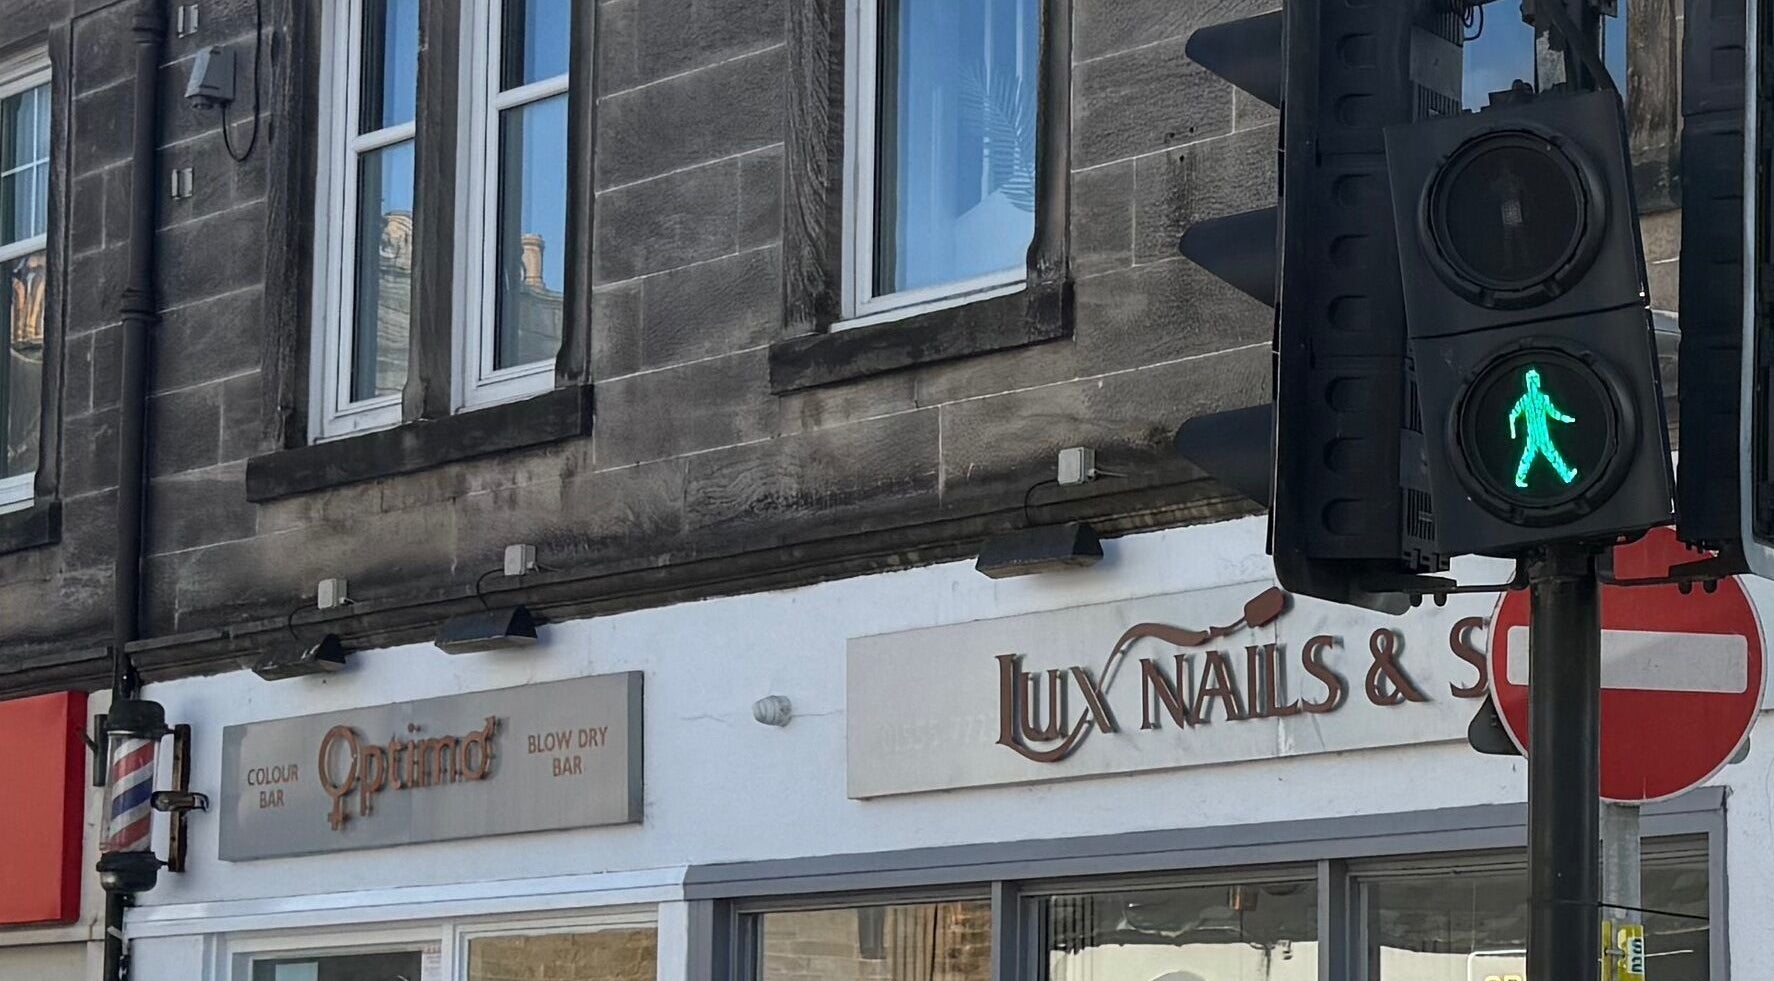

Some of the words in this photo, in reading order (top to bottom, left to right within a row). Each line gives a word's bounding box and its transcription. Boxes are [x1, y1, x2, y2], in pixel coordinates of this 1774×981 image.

[995, 645, 1118, 763] LUX
[1140, 634, 1342, 730] NAILS
[1365, 627, 1430, 706] &
[527, 729, 573, 754] BLOW
[577, 727, 609, 748] DRY
[247, 764, 299, 787] COLOUR
[552, 757, 583, 777] BAR
[258, 789, 285, 809] BAR
